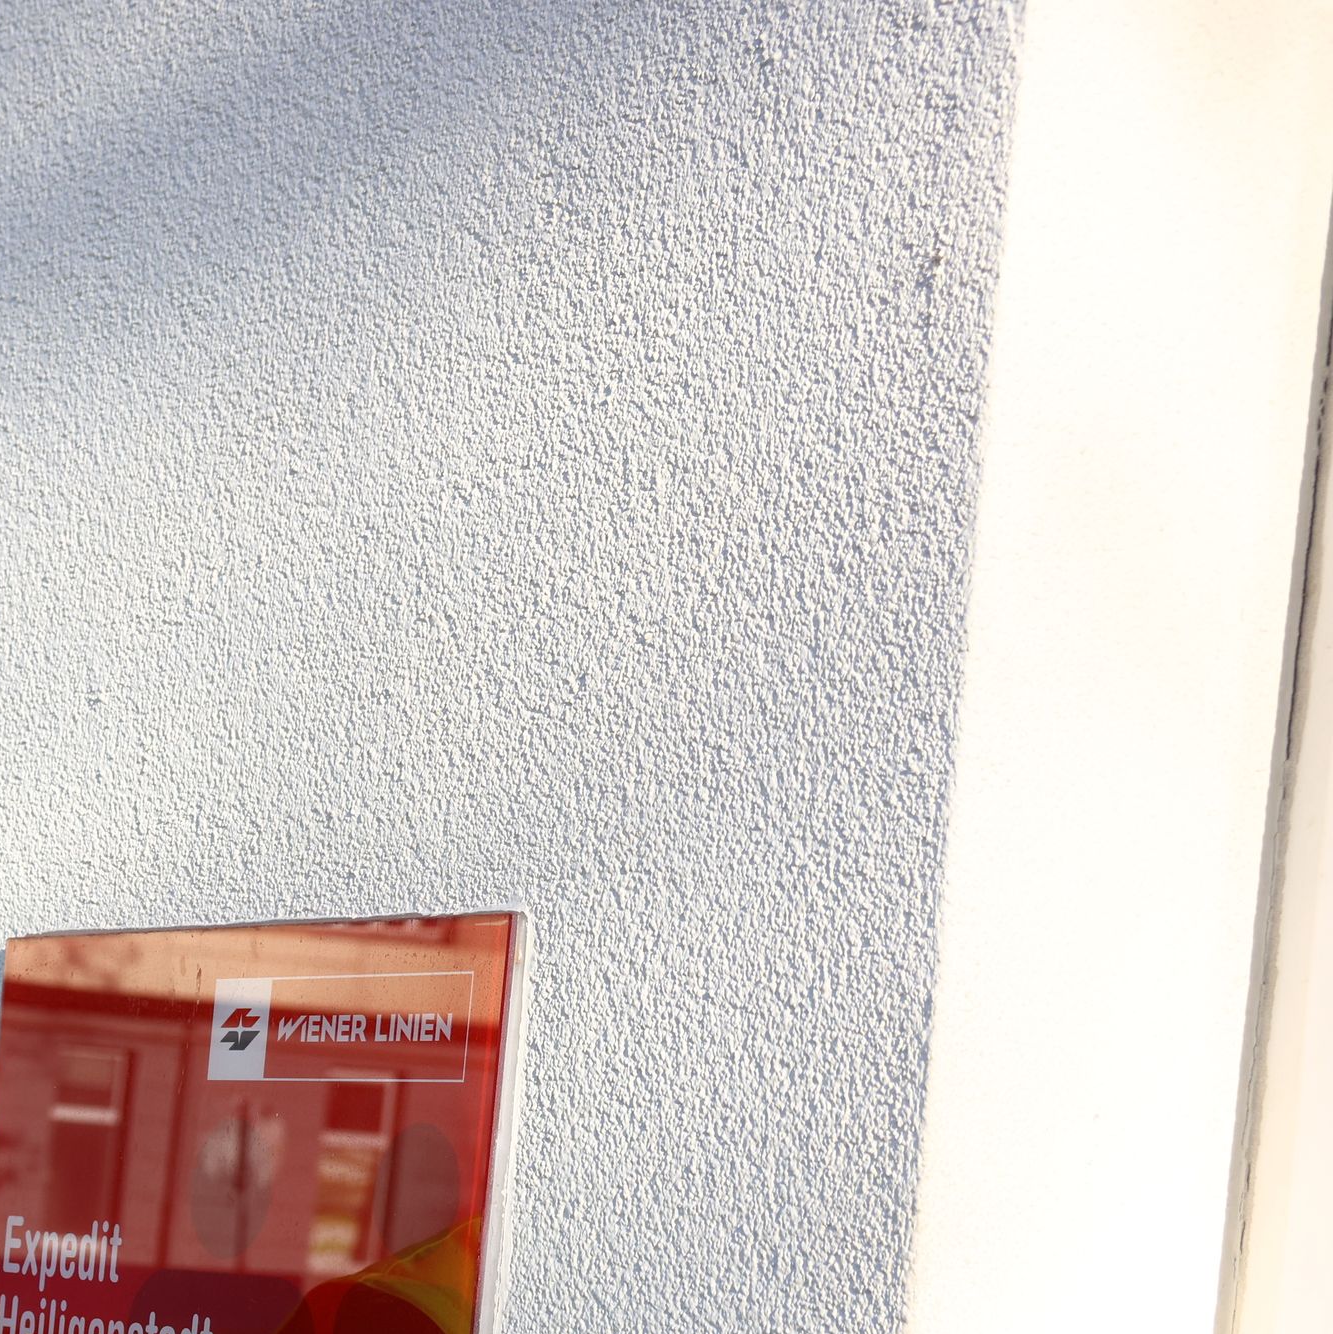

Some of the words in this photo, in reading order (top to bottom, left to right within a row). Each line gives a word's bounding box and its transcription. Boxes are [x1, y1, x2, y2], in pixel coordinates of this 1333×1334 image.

[276, 1014, 367, 1043] WIENER
[374, 1012, 453, 1042] LINIEN
[2, 1215, 123, 1292] Expedit
